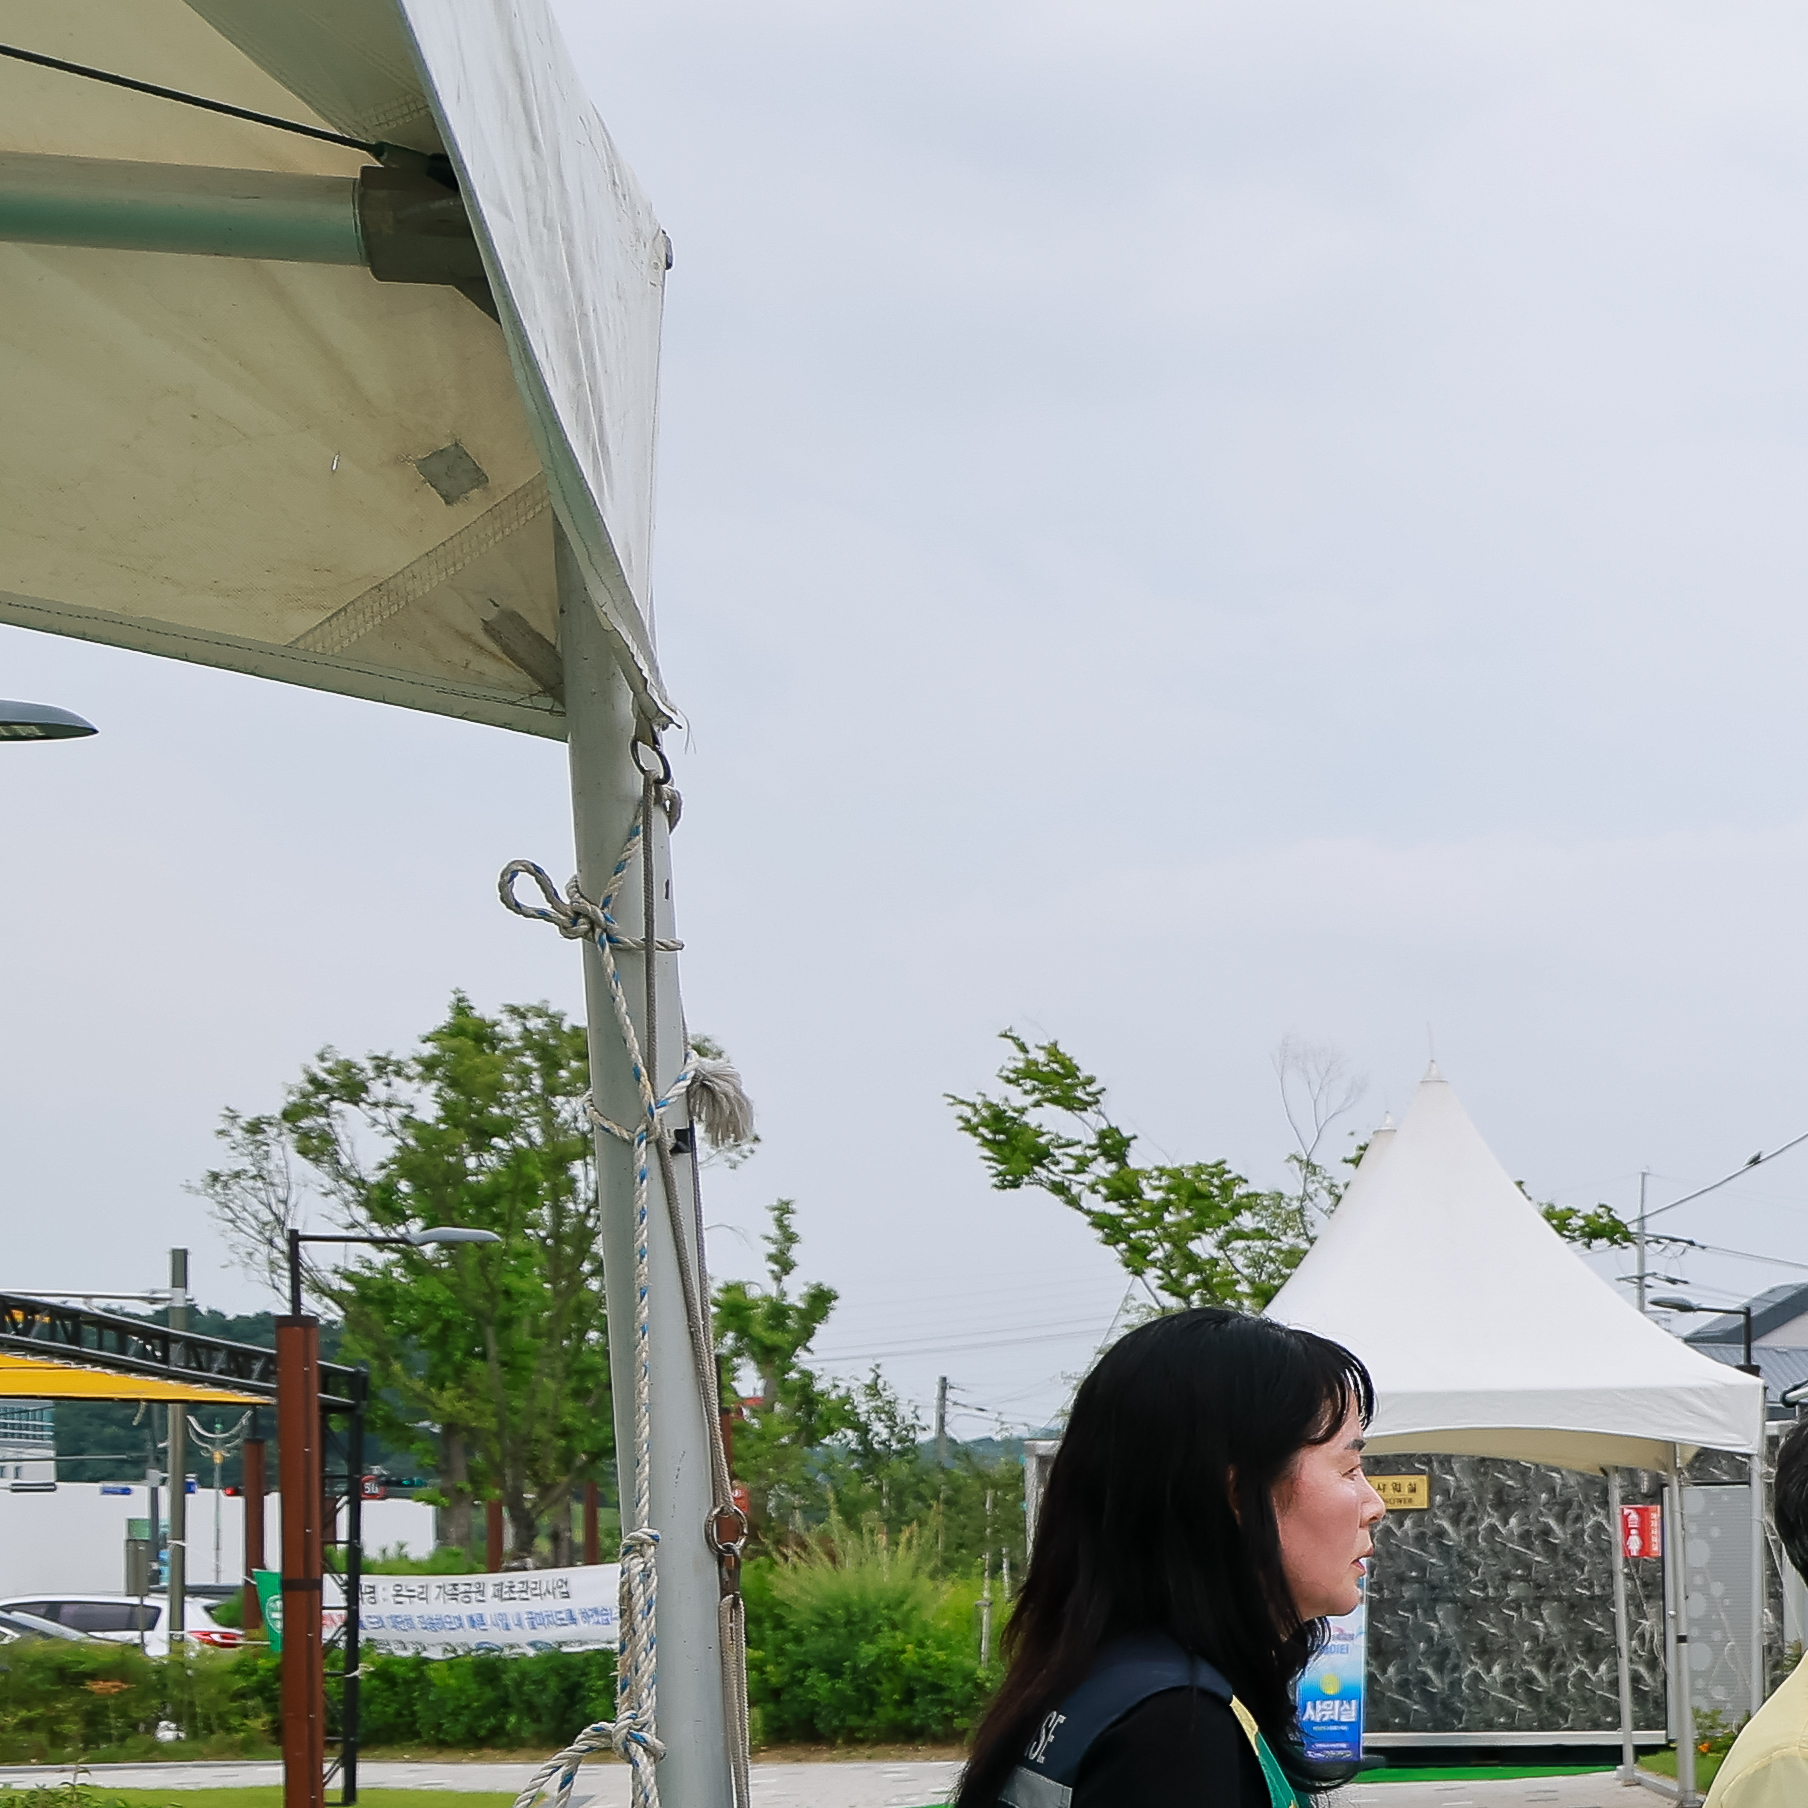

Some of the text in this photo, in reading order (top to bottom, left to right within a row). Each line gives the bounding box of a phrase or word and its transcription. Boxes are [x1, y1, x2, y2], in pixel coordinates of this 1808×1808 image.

[391, 1583, 429, 1605] 온누리
[435, 1581, 487, 1604] 가족공원
[1302, 1699, 1358, 1722] 샤워실
[1028, 1710, 1067, 1764] SE
